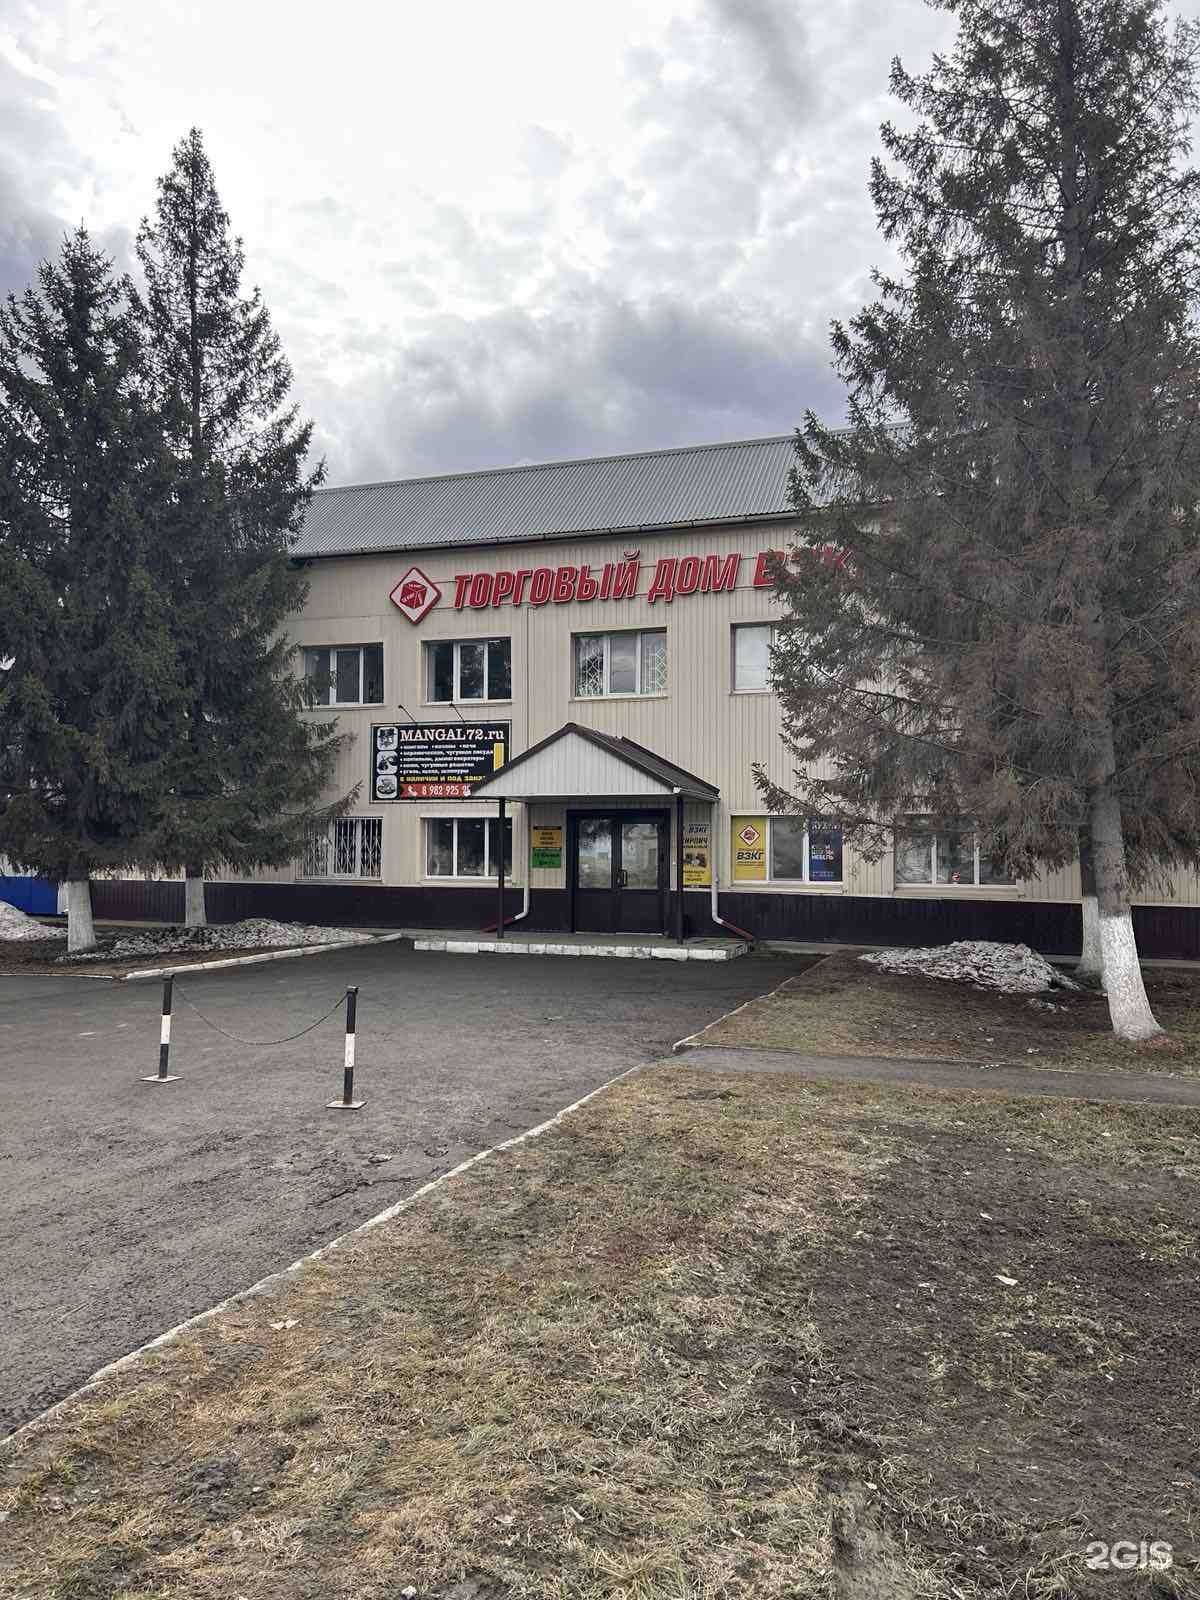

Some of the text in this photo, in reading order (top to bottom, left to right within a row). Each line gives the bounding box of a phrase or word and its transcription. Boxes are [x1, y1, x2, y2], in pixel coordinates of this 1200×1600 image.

[454, 550, 641, 610] ТОРГОВЫЙ
[647, 552, 742, 603] ДОМ
[400, 728, 505, 742] MANGAL72.ru
[421, 785, 427, 795] 8
[429, 785, 443, 795] 982
[446, 785, 459, 795] 925
[737, 850, 765, 860] ВЗКГ
